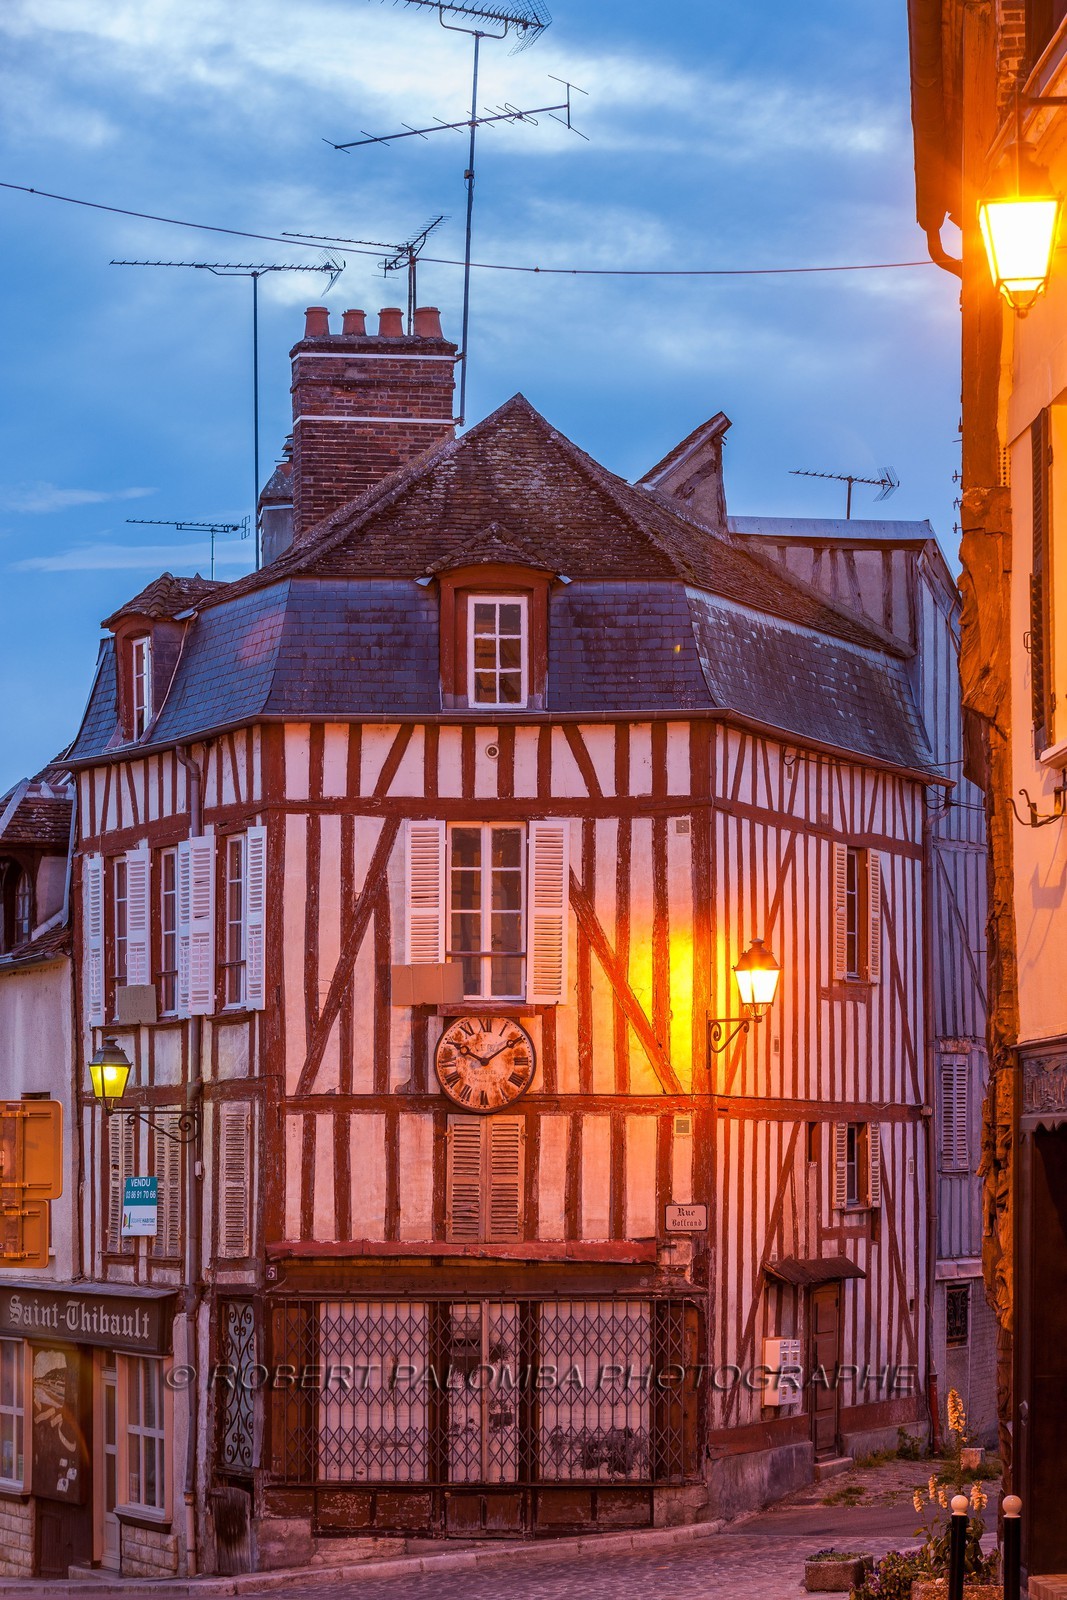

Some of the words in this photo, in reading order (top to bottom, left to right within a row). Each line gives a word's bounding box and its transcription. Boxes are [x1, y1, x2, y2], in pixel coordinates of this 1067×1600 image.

[130, 1178, 151, 1187] VENDU
[137, 1190, 142, 1199] 91
[143, 1190, 149, 1199] 70
[150, 1190, 157, 1199] 66
[677, 1208, 695, 1216] Rue
[267, 1267, 275, 1279] 5
[9, 1295, 150, 1339] Saint-Thibault
